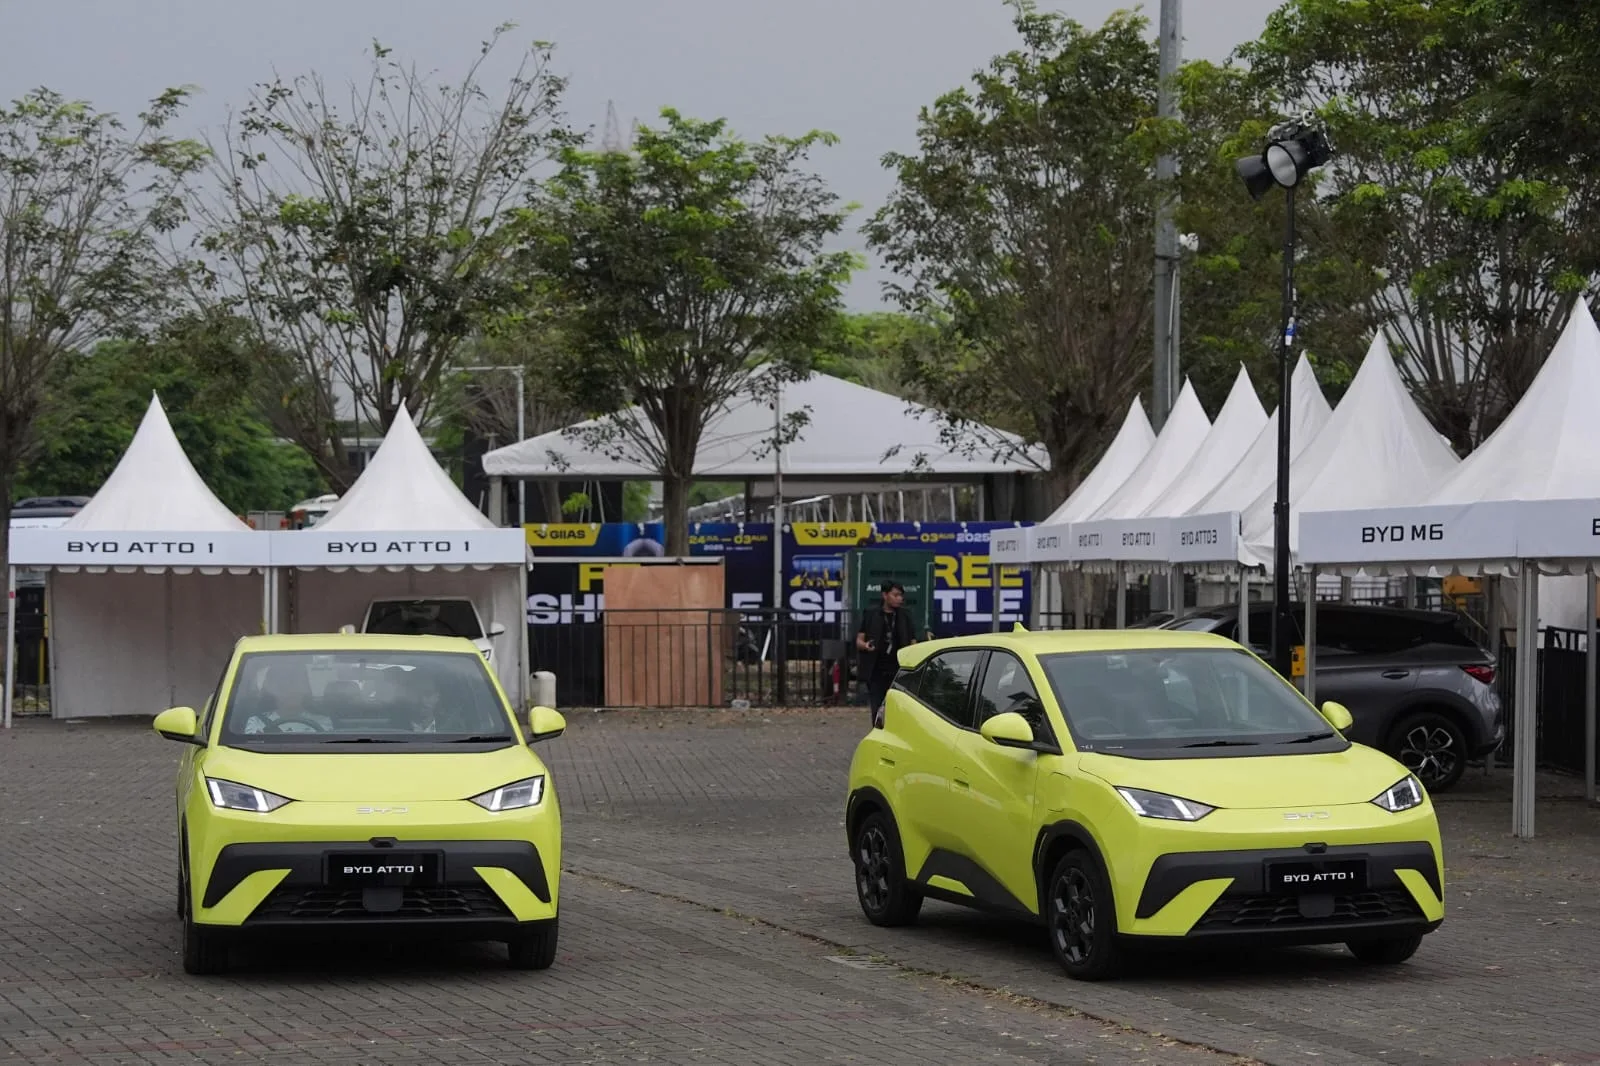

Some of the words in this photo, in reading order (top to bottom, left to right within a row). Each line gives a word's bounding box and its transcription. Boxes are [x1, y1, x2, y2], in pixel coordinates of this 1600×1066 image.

[550, 530, 586, 539] GIIAS
[821, 529, 857, 538] GIIAS
[956, 533, 991, 542] 2025
[1181, 531, 1194, 545] BYD
[1194, 530, 1212, 544] ATTO
[1212, 529, 1218, 544] 3
[1361, 525, 1405, 543] BYD
[1411, 523, 1444, 541] M6
[1122, 533, 1134, 546] BYD
[1135, 532, 1151, 546] ATTO
[67, 541, 119, 553] BYD
[127, 541, 195, 553] ATTO
[207, 542, 214, 553] 1
[327, 541, 377, 553] BYD
[386, 541, 451, 552] ATTO
[464, 541, 470, 552] 1
[343, 866, 373, 874] BYD
[376, 865, 415, 873] ATTO
[419, 865, 424, 873] 1
[1283, 874, 1310, 882] BYD
[1313, 872, 1347, 881] ATTO
[1350, 871, 1355, 880] 1
